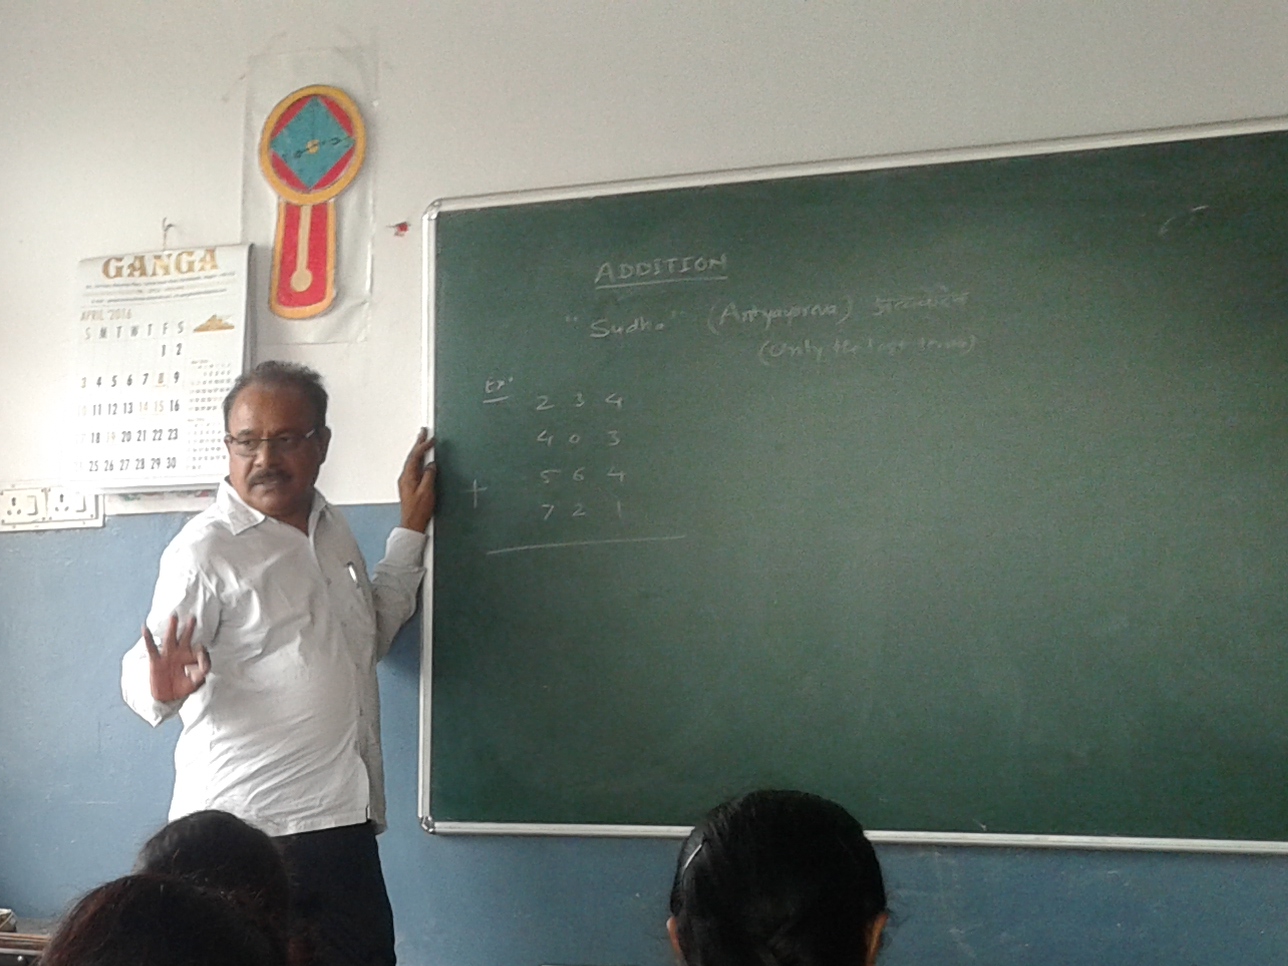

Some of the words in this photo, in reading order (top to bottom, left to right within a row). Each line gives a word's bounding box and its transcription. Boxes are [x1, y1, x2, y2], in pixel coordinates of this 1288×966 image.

[102, 248, 220, 280] GANGA
[593, 253, 728, 284] ADDITION
[92, 403, 102, 416] 11
[107, 402, 118, 415] 12
[123, 401, 134, 414] 13
[169, 399, 180, 412] 16
[91, 432, 101, 444] 18
[121, 430, 132, 443] 20
[136, 429, 147, 442] 21
[151, 428, 163, 441] 22
[167, 427, 179, 441] 23
[89, 460, 99, 472] 25
[104, 459, 114, 472] 26
[119, 458, 130, 471] 27
[135, 457, 145, 470] 28
[150, 457, 161, 470] 29
[166, 456, 177, 469] 30
